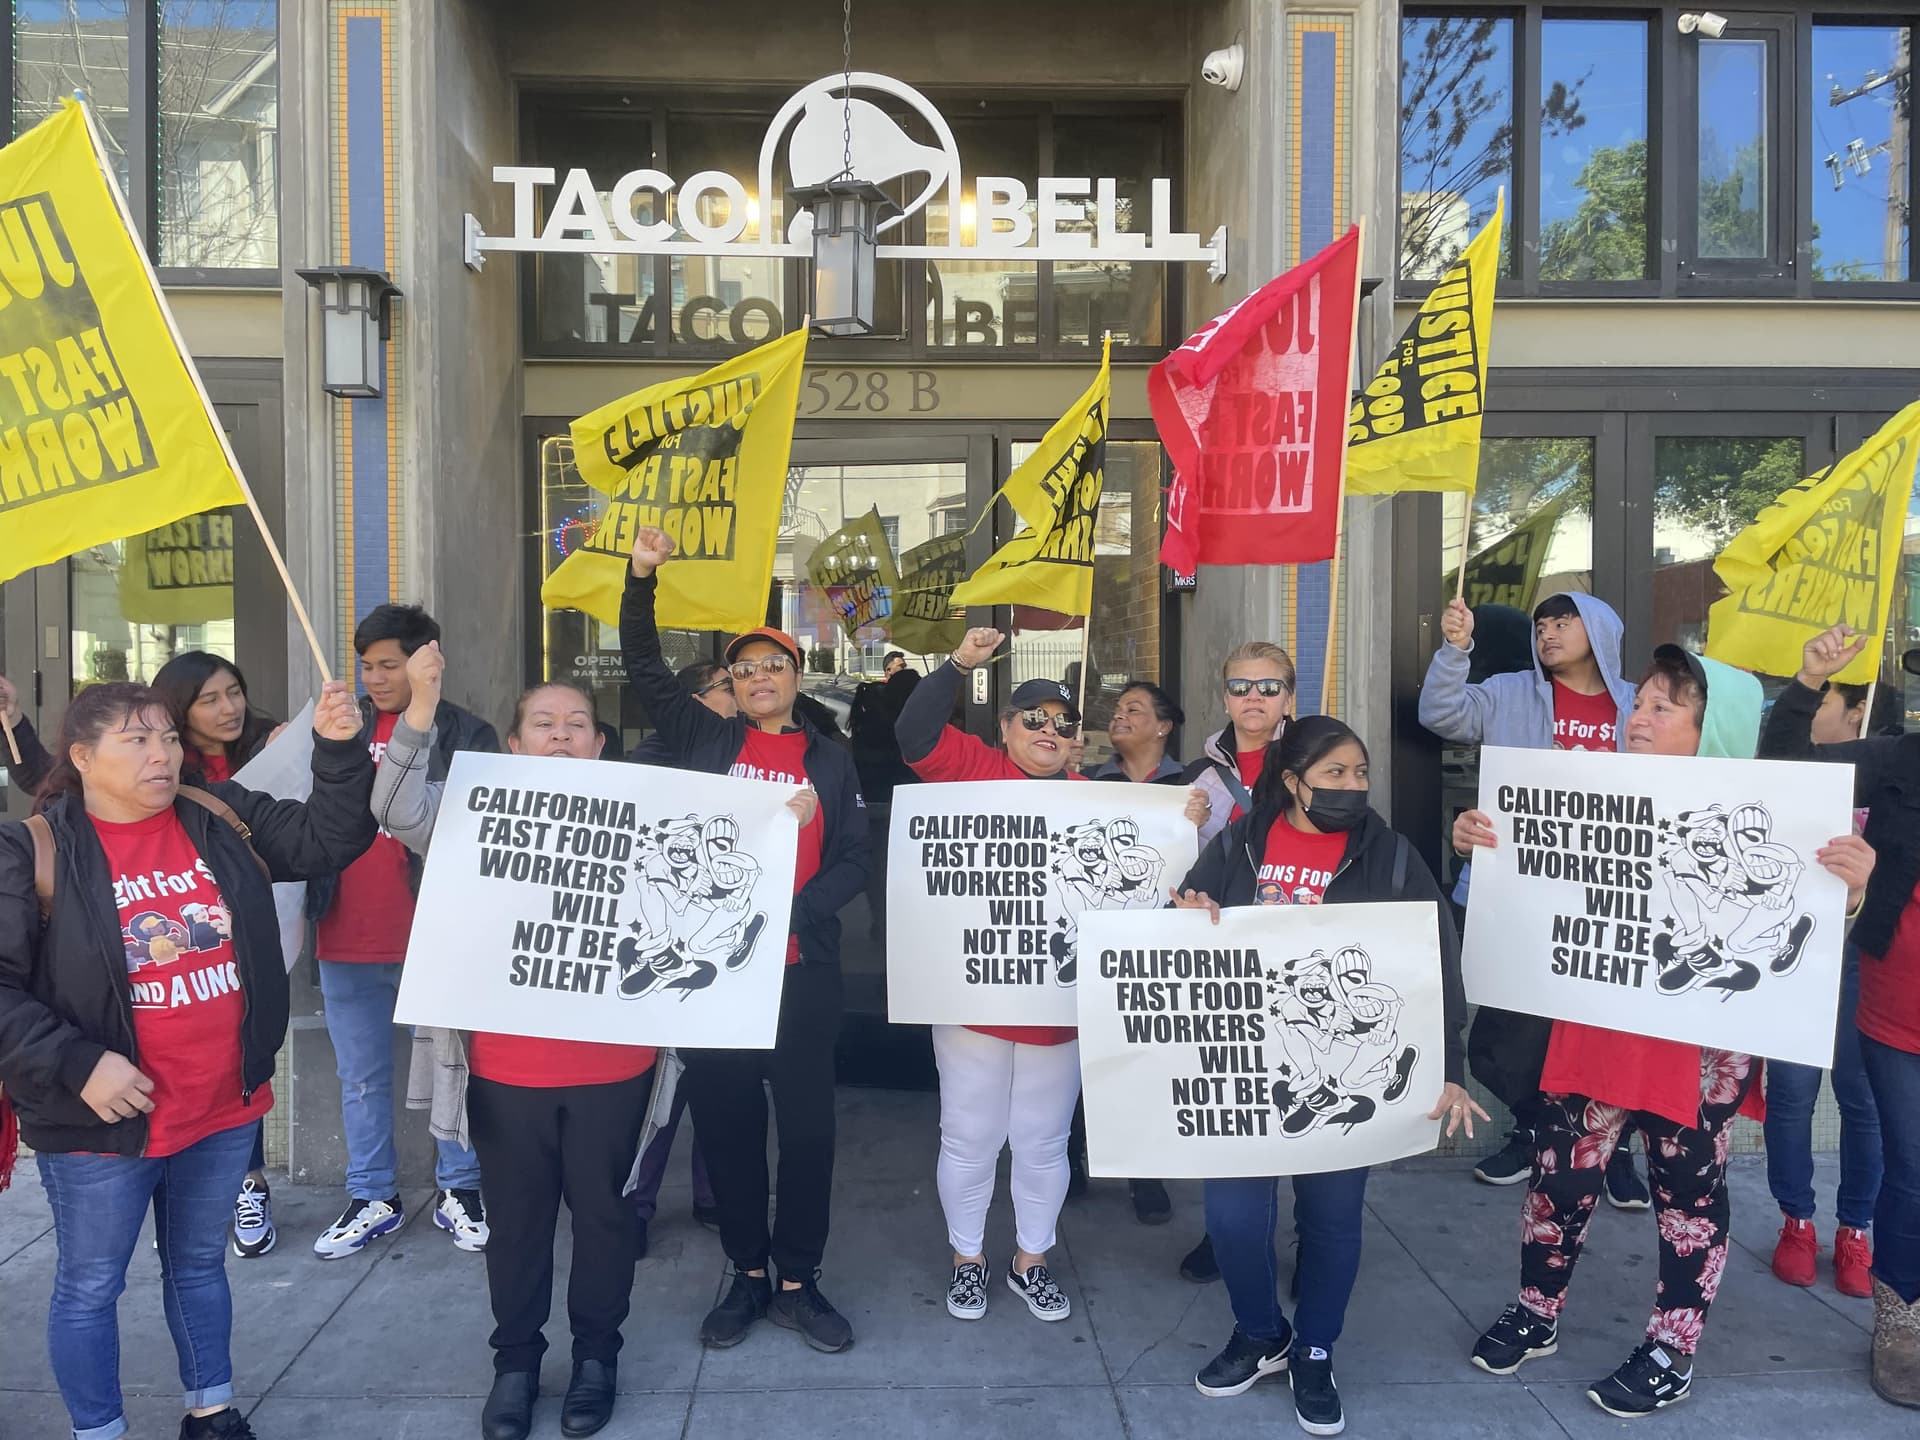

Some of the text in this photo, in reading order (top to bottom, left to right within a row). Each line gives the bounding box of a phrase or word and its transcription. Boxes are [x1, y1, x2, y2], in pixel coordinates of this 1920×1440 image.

[492, 166, 1201, 249] TACO BELL
[1401, 338, 1414, 368] FOR
[798, 370, 940, 414] 528 B
[574, 655, 623, 667] OPEN
[1568, 719, 1597, 738] For
[467, 785, 636, 831] CALIFORNIA
[1498, 784, 1656, 826] CALIFORNIA
[477, 815, 634, 862] FAST FOOD
[909, 814, 1048, 841] CALIFORNIA
[1512, 816, 1653, 858] FAST FOOD
[921, 842, 1047, 868] FAST FOOD
[1517, 847, 1653, 891] WORKERS
[152, 870, 198, 897] For
[479, 847, 628, 895] WORKERS
[926, 870, 1048, 897] WORKERS
[1299, 867, 1333, 888] FOR
[552, 890, 620, 928] WILL
[988, 900, 1048, 926] WILL
[1585, 886, 1652, 923] WILL
[512, 919, 618, 961] NOT BE
[963, 928, 1048, 955] NOT BE
[1551, 914, 1651, 956] NOT BE
[509, 954, 613, 995] SILENT
[965, 957, 1048, 985] SILENT
[1100, 948, 1264, 979] CALIFORNIA
[1551, 946, 1649, 988] SILENT
[170, 974, 192, 1008] A
[1116, 981, 1264, 1011] FAST FOOD
[1123, 1013, 1266, 1044] WORKERS
[1198, 1045, 1268, 1074] WILL
[1171, 1077, 1270, 1106] NOT BE
[1176, 1108, 1271, 1137] SILENT
